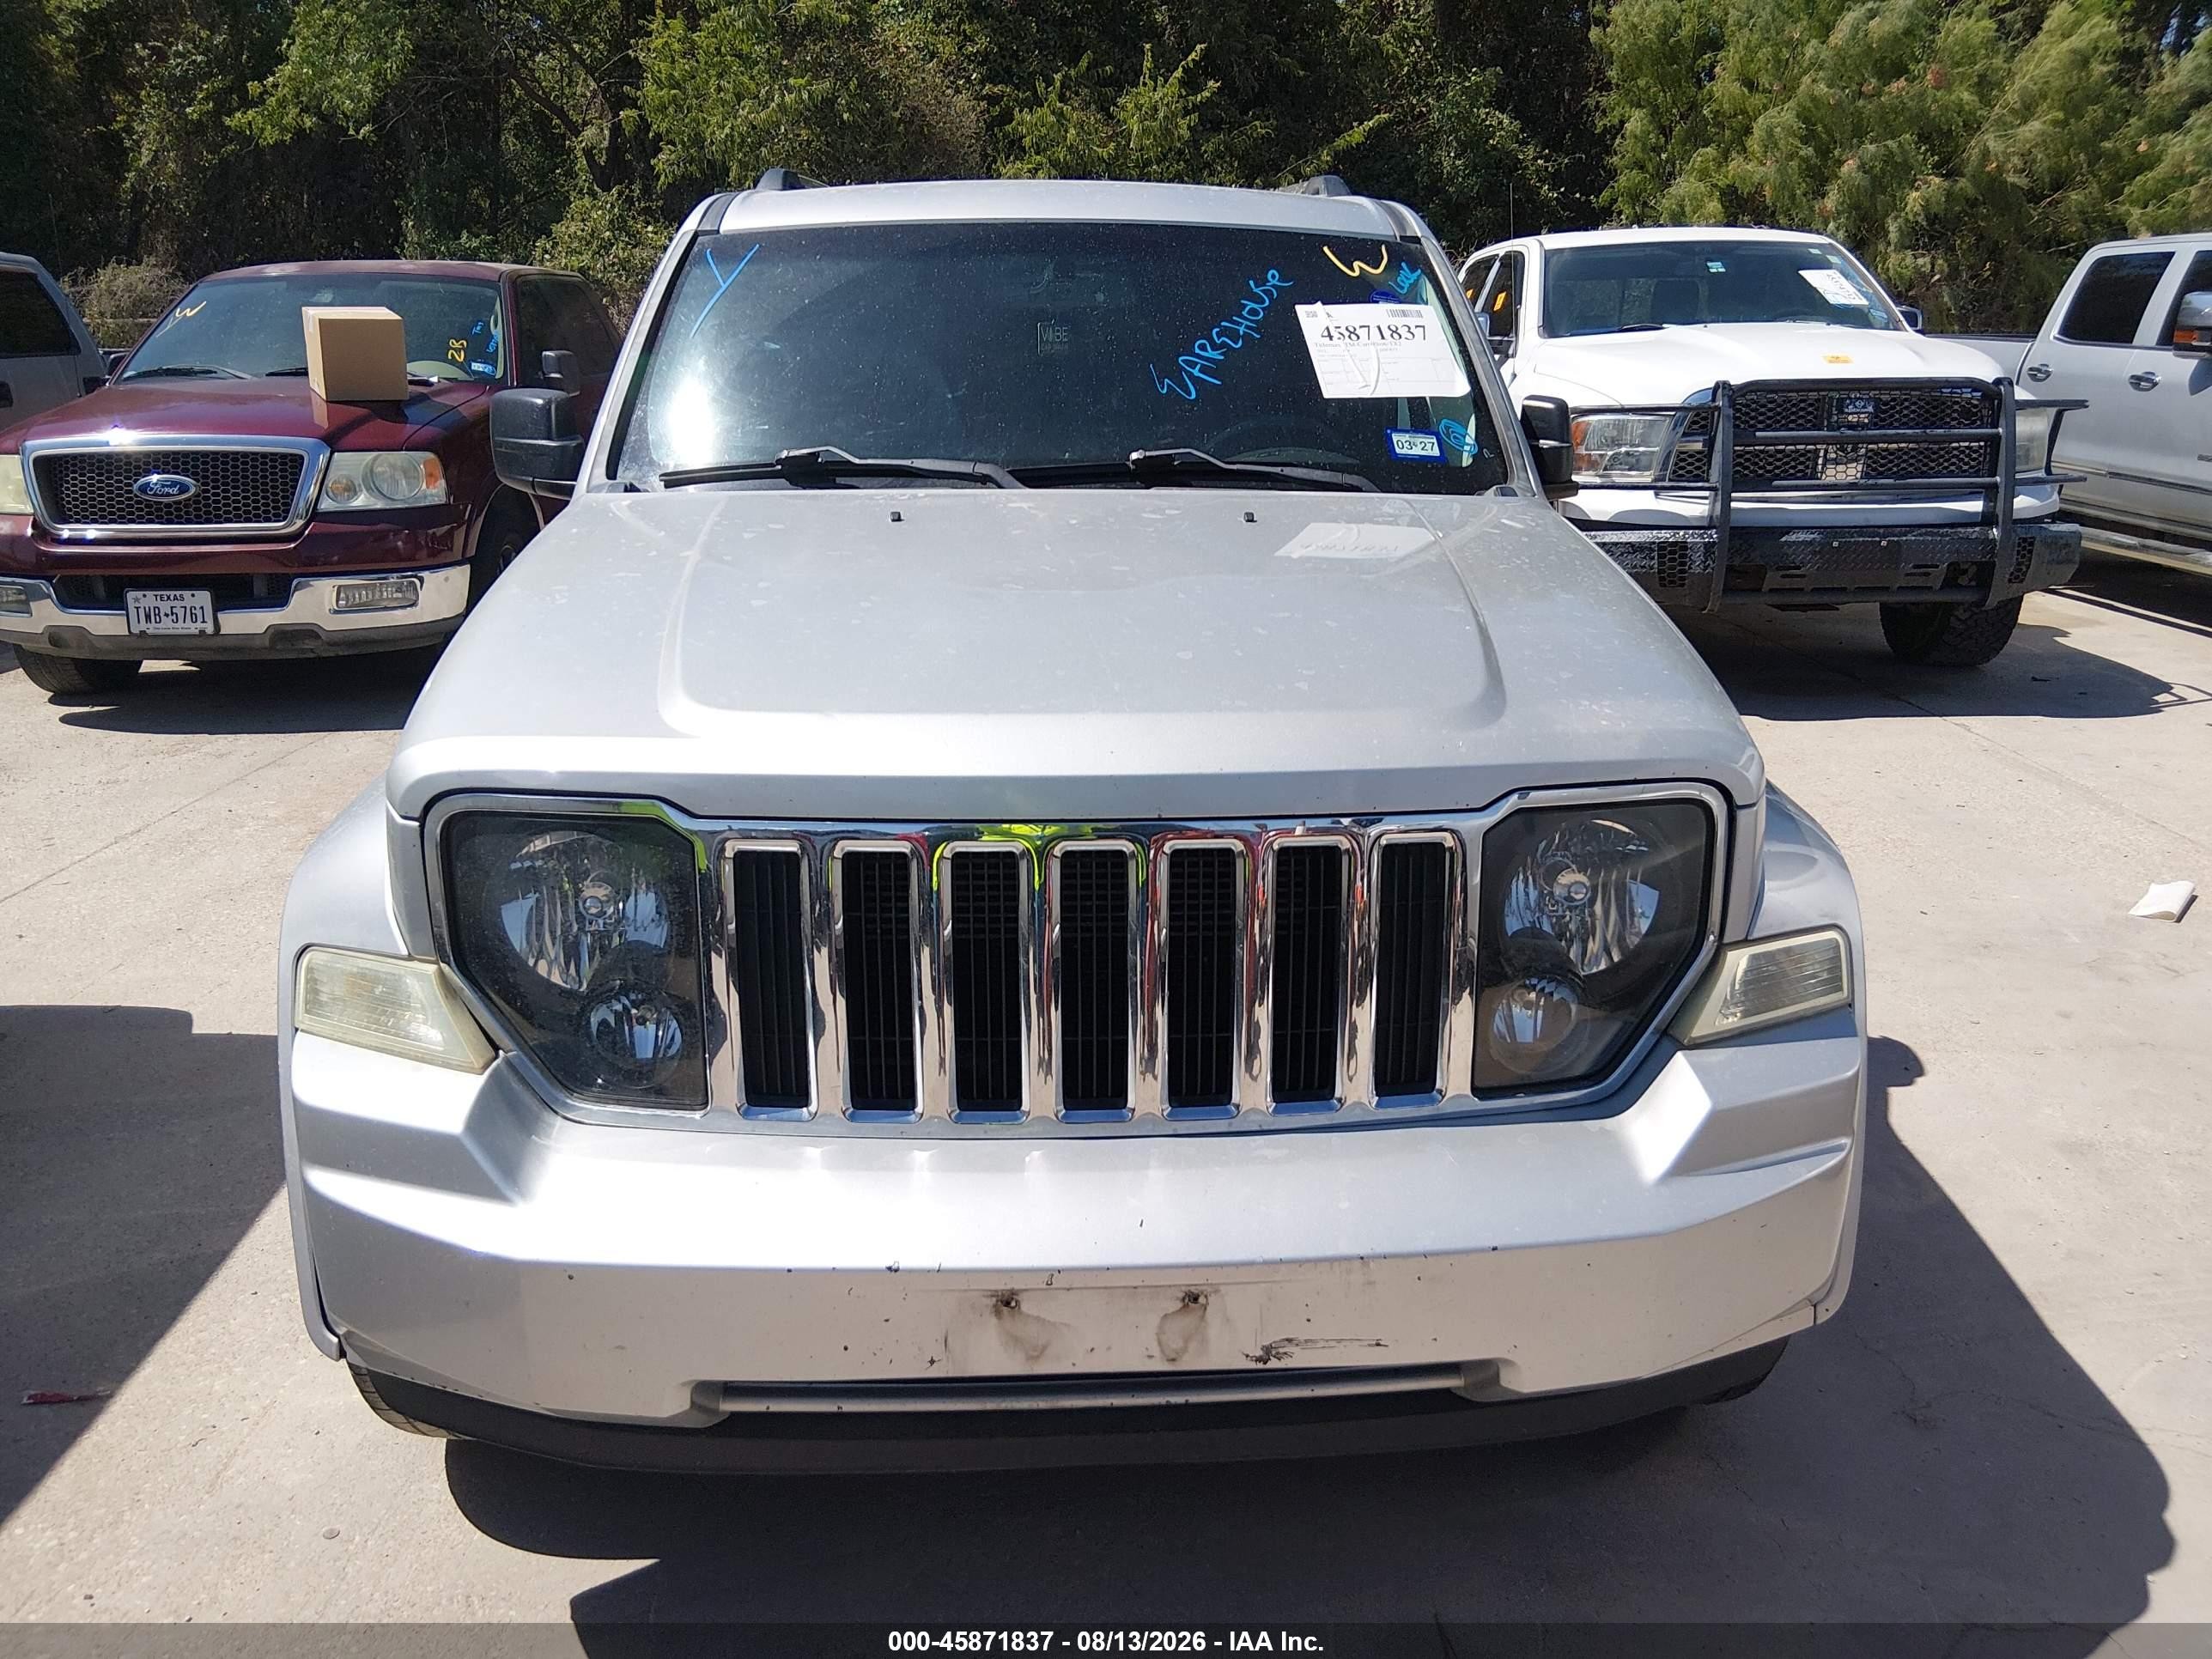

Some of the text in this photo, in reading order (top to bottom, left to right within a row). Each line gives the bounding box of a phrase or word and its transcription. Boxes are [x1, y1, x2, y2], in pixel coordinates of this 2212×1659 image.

[690, 244, 760, 338] Y
[1321, 324, 1427, 342] 45871837
[1395, 439, 1436, 452] 03 27
[147, 480, 180, 495] Ford
[153, 593, 185, 602] TEXAS
